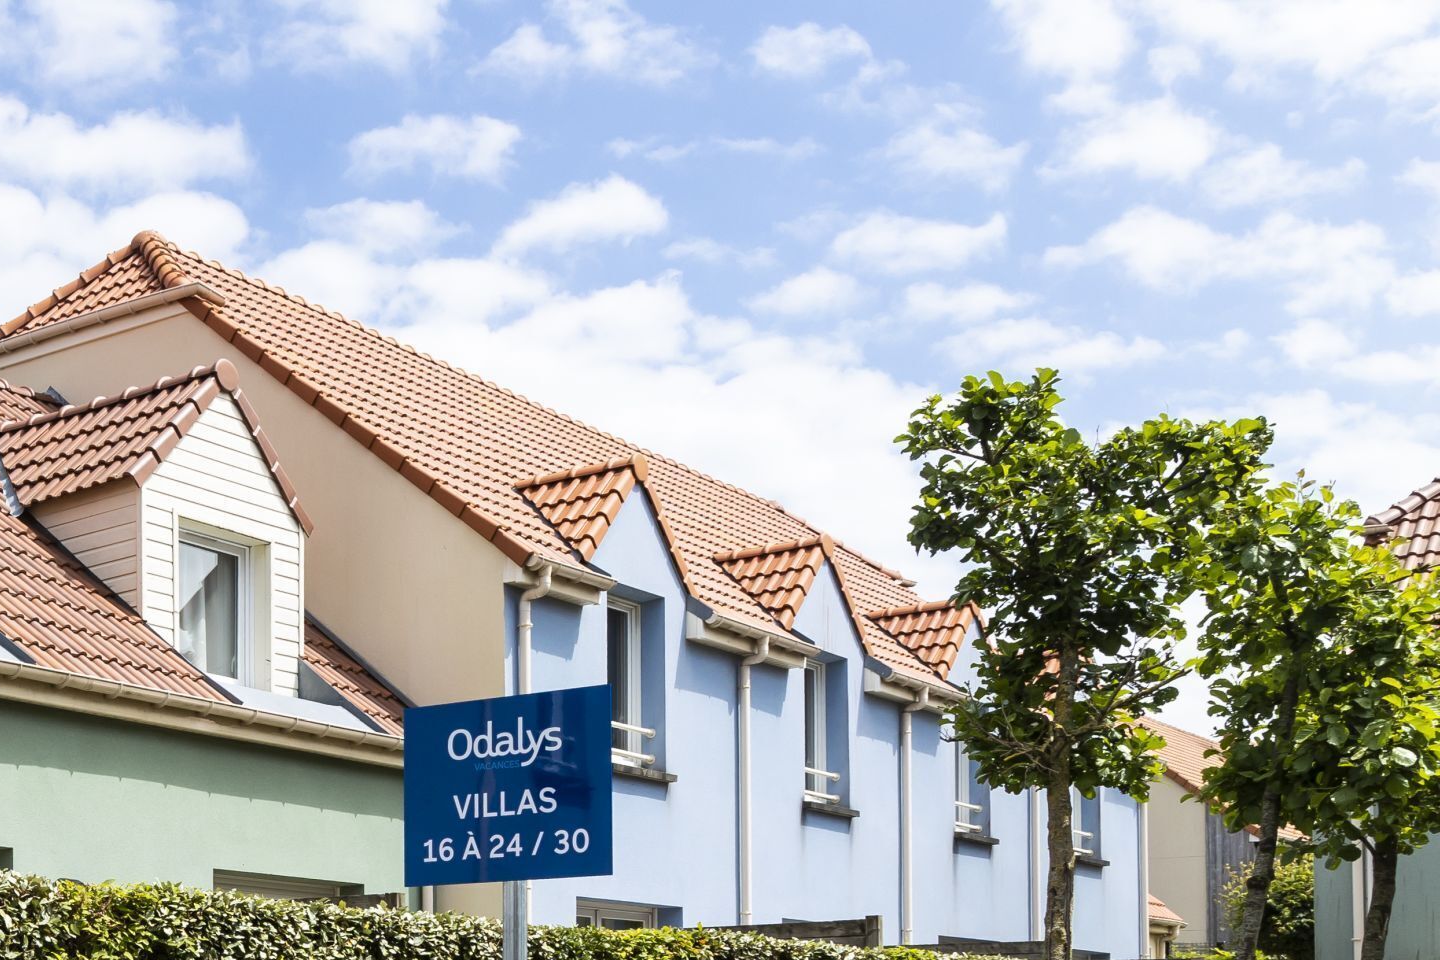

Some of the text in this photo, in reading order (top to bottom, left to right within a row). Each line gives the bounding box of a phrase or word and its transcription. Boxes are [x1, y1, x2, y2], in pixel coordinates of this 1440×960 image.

[448, 717, 562, 767] Odalys
[474, 760, 520, 771] VACANCES
[453, 787, 558, 819] VILLAS
[423, 828, 590, 863] 16 À 24 / 30
